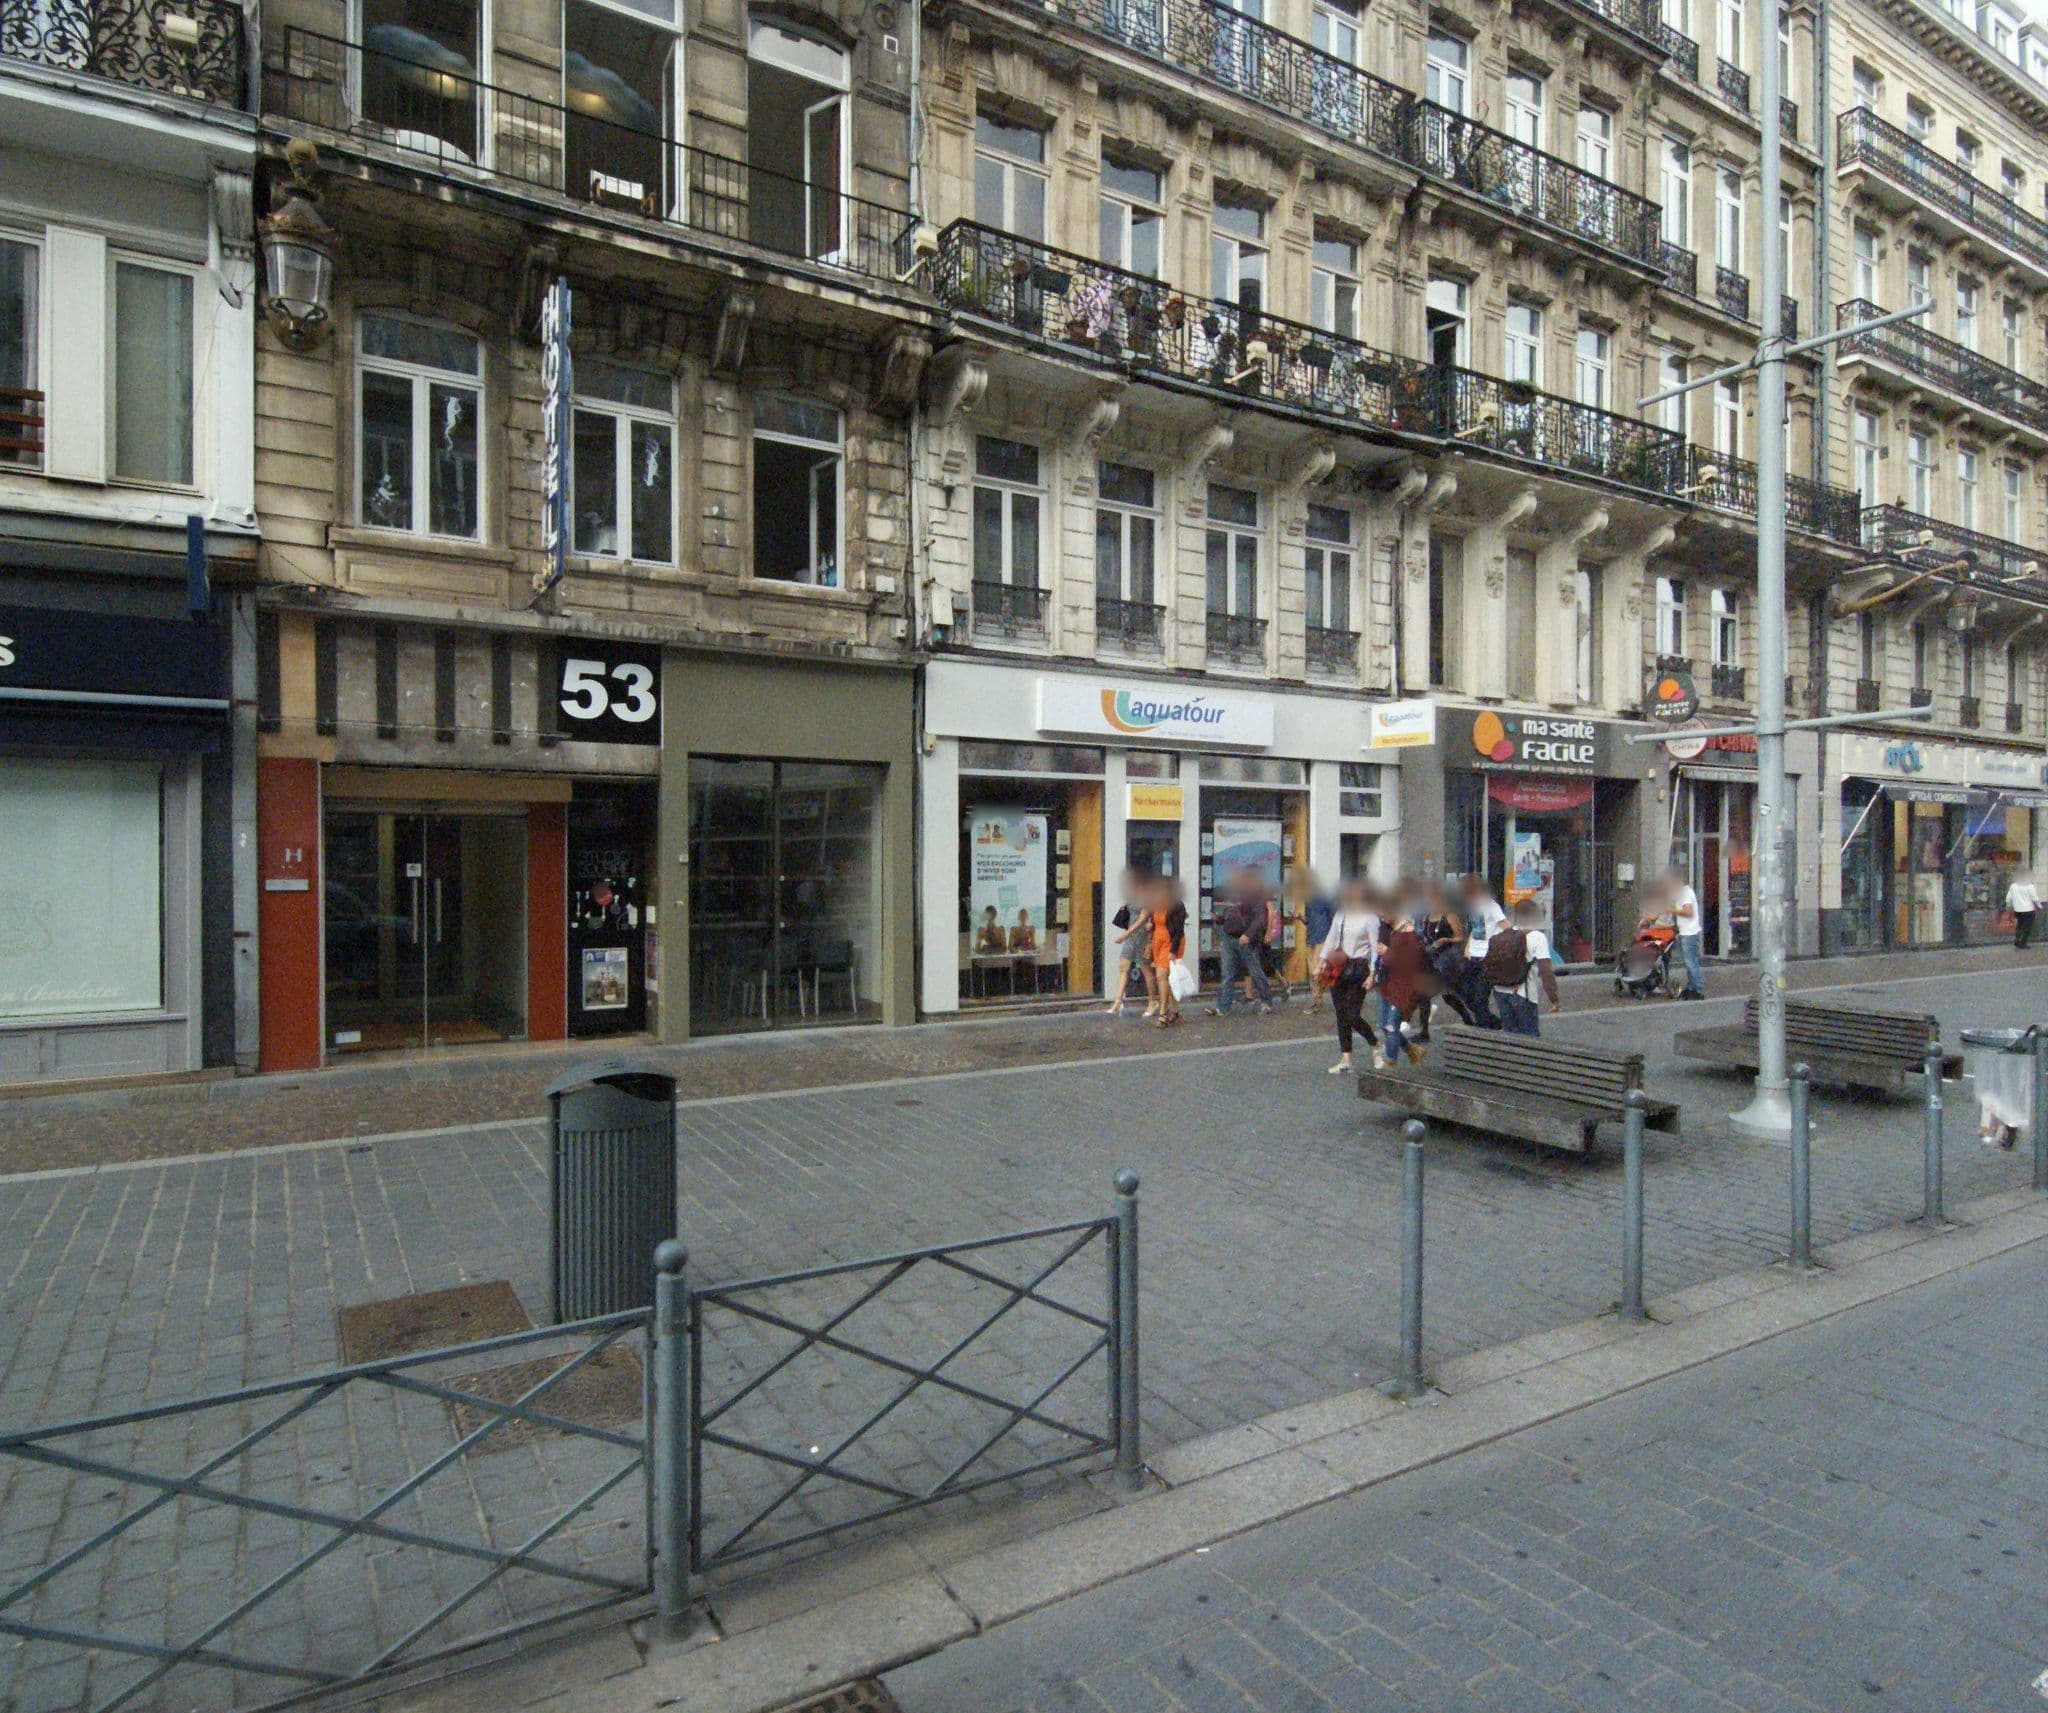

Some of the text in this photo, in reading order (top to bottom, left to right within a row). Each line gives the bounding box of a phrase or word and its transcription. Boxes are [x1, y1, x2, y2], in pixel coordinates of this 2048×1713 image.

[541, 283, 559, 550] HOTEL
[560, 658, 656, 723] 53
[1130, 698, 1225, 725] aquatour
[1522, 719, 1595, 740] ma santé
